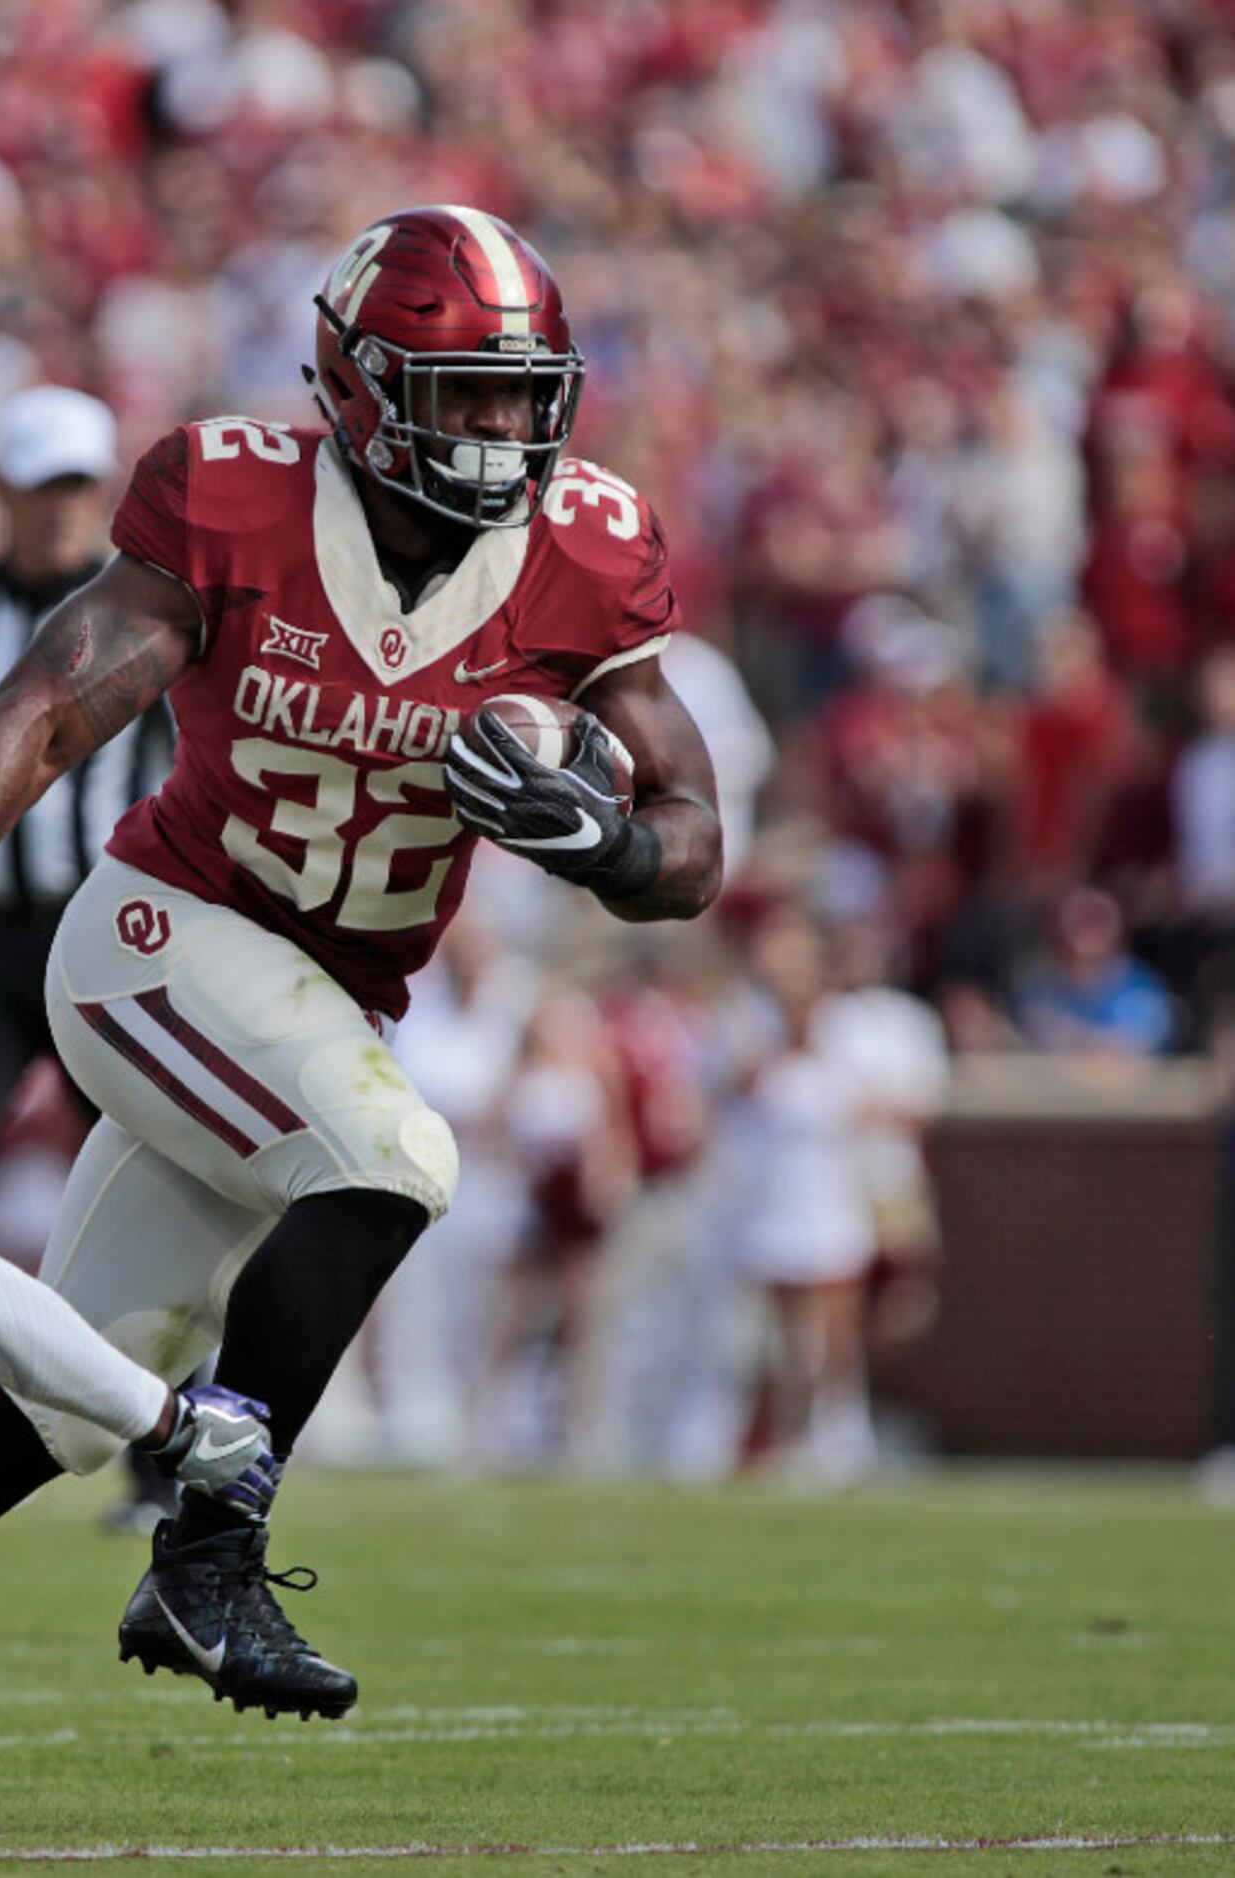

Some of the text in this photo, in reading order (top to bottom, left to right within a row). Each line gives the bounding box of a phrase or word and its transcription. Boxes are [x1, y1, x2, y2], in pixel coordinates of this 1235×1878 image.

[380, 628, 407, 668] OU
[220, 736, 464, 932] 32
[115, 899, 170, 955] OU
